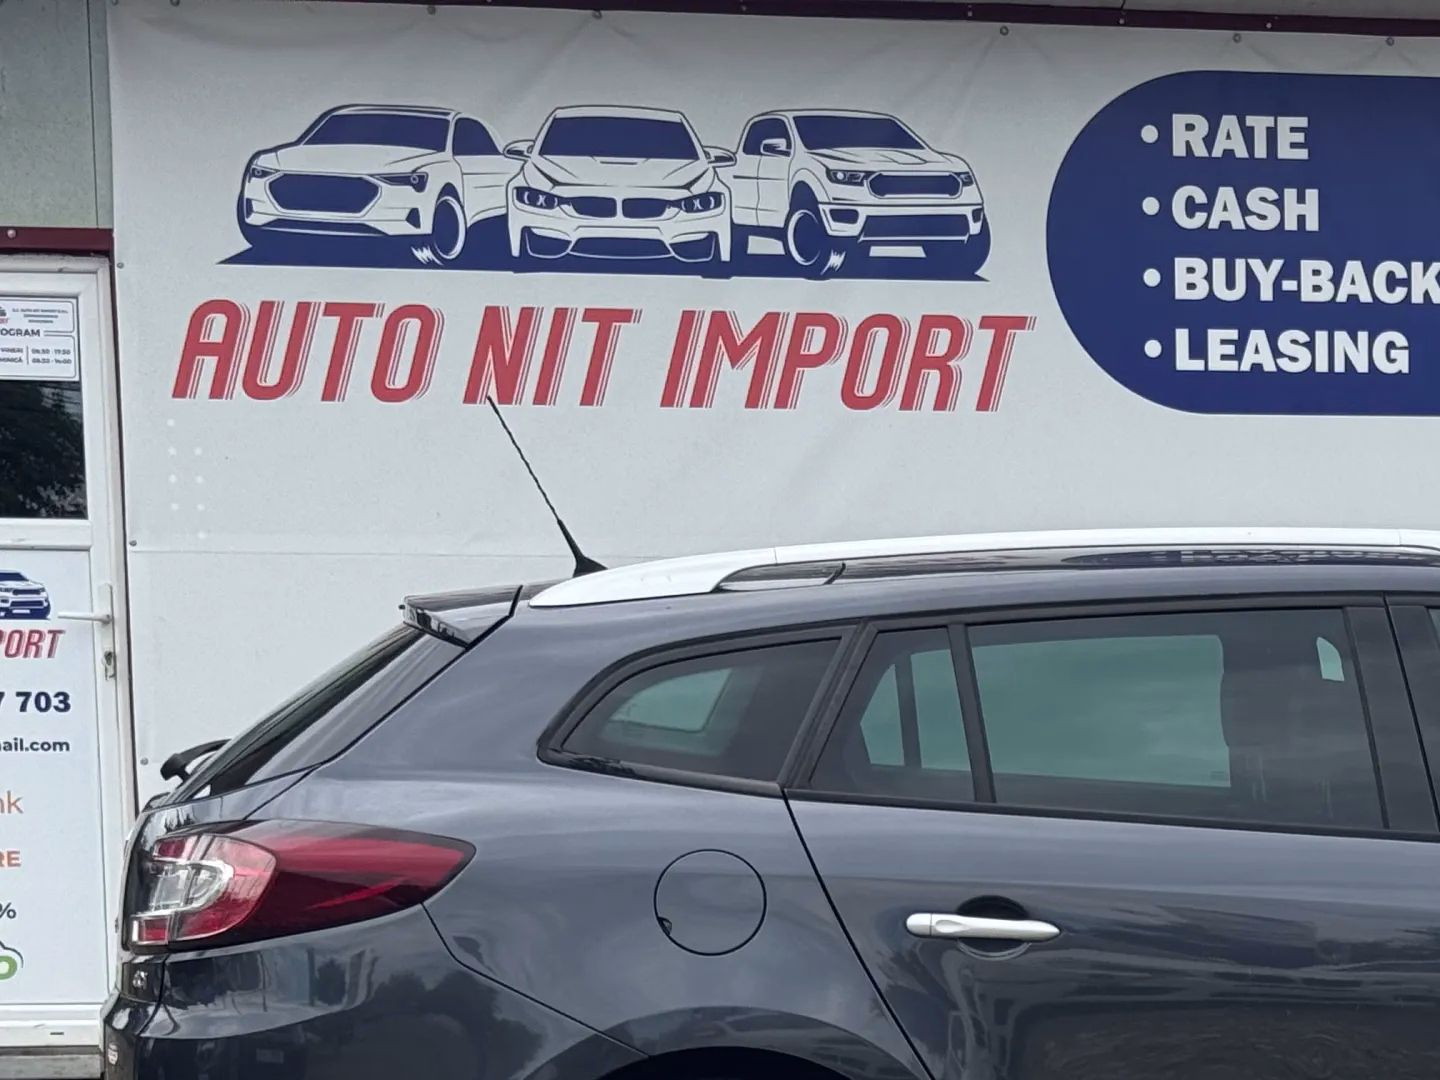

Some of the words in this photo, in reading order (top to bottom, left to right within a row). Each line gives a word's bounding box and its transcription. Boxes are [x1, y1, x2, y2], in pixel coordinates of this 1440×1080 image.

[1172, 113, 1309, 160] RATE
[1171, 185, 1319, 231] CASH
[171, 298, 445, 404] AUTO
[462, 305, 643, 407] NIT
[659, 309, 1038, 413] IMPORT
[1175, 328, 1410, 375] LEASING
[15, 691, 71, 713] 703
[0, 737, 70, 752] ail.com
